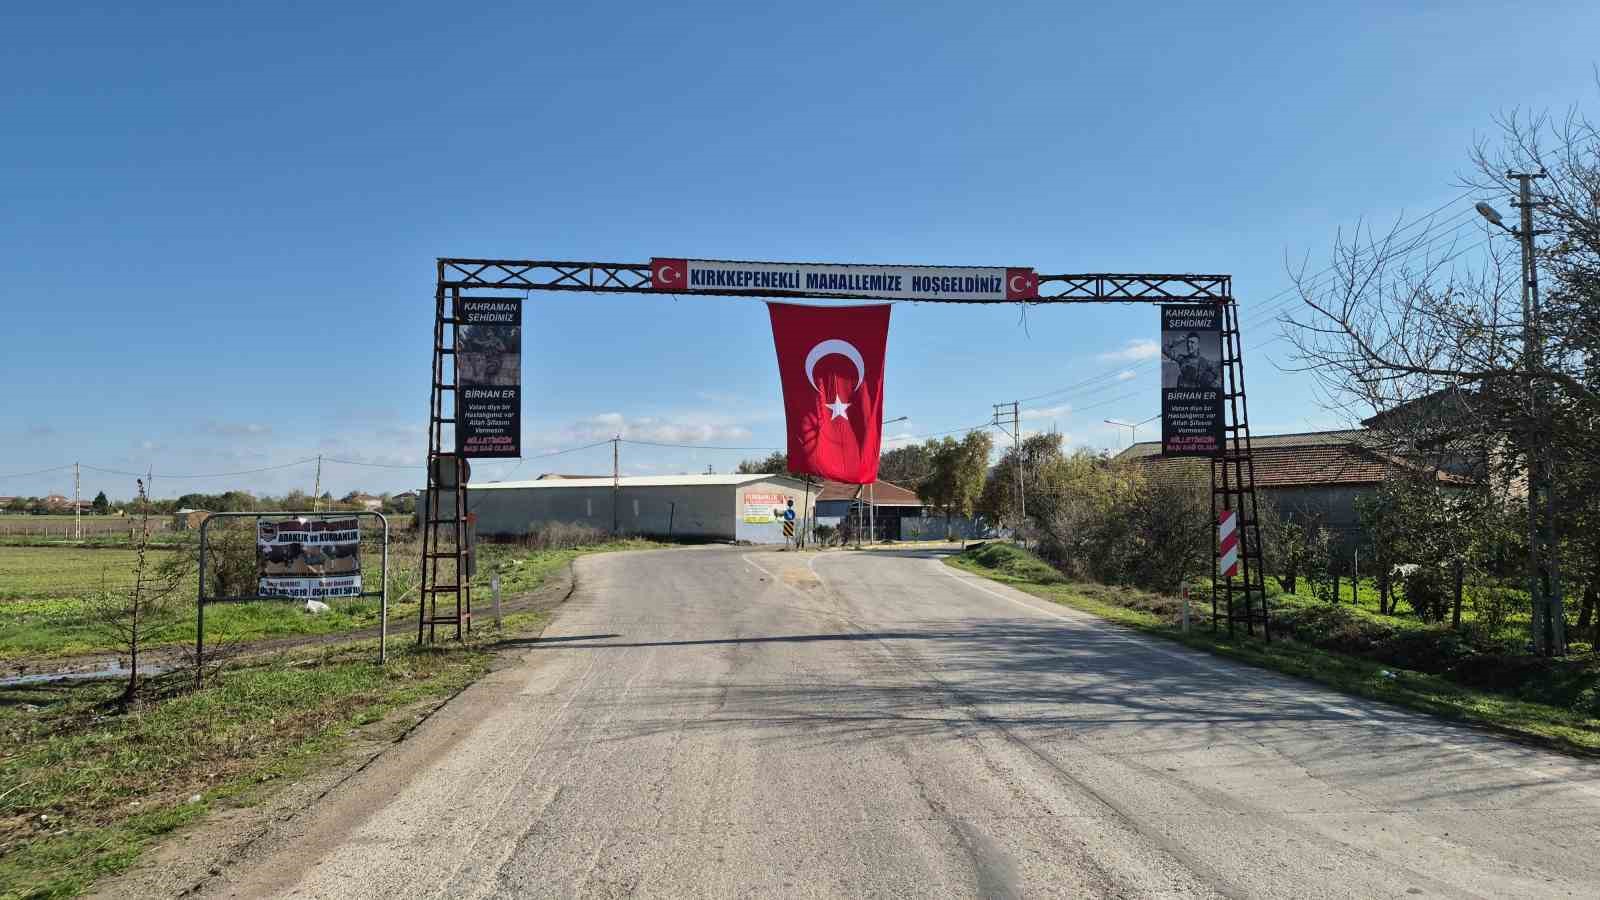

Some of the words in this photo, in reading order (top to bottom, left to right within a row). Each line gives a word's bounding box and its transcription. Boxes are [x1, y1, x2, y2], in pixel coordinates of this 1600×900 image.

[691, 269, 800, 288] KIRKKEPENEKLİ
[806, 271, 902, 292] MAHALLEMİZE
[912, 274, 1003, 295] HOŞGELDİNİZ
[464, 302, 517, 311] KAHRAMAN
[1165, 309, 1215, 318] KAHRAMAN
[465, 388, 500, 399] BİRHAN
[502, 390, 516, 399] ER
[1167, 391, 1202, 400] BİRHAN
[1203, 391, 1216, 400] ER
